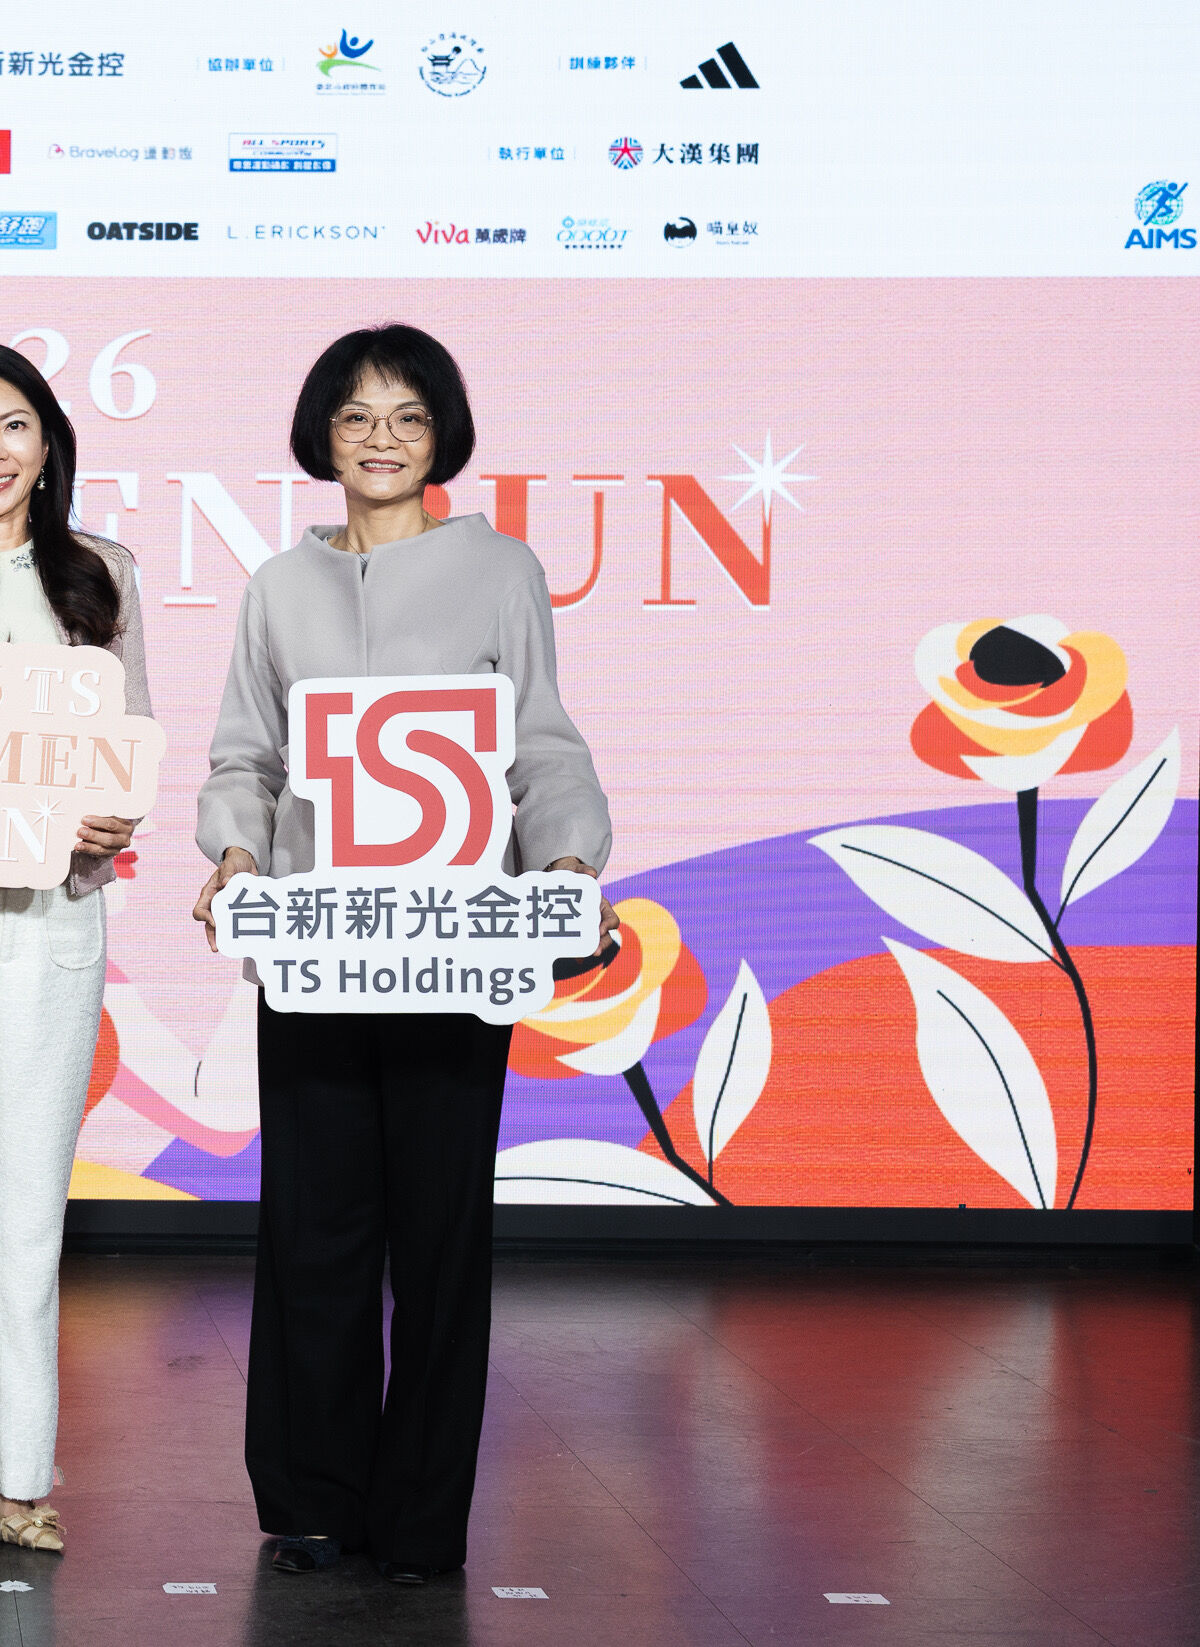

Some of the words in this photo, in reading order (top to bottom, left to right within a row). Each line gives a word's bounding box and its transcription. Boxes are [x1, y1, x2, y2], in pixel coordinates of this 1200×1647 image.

[498, 146, 565, 161] 執行單位
[653, 142, 760, 166] 大漢集團
[86, 221, 200, 241] OATSIDE
[475, 227, 527, 244] 萬歲牌
[1124, 228, 1197, 249] AIMS
[24, 667, 102, 717] TS
[227, 884, 584, 940] 台新新光金控
[273, 958, 321, 994] TS
[339, 957, 536, 1006] Holdings
